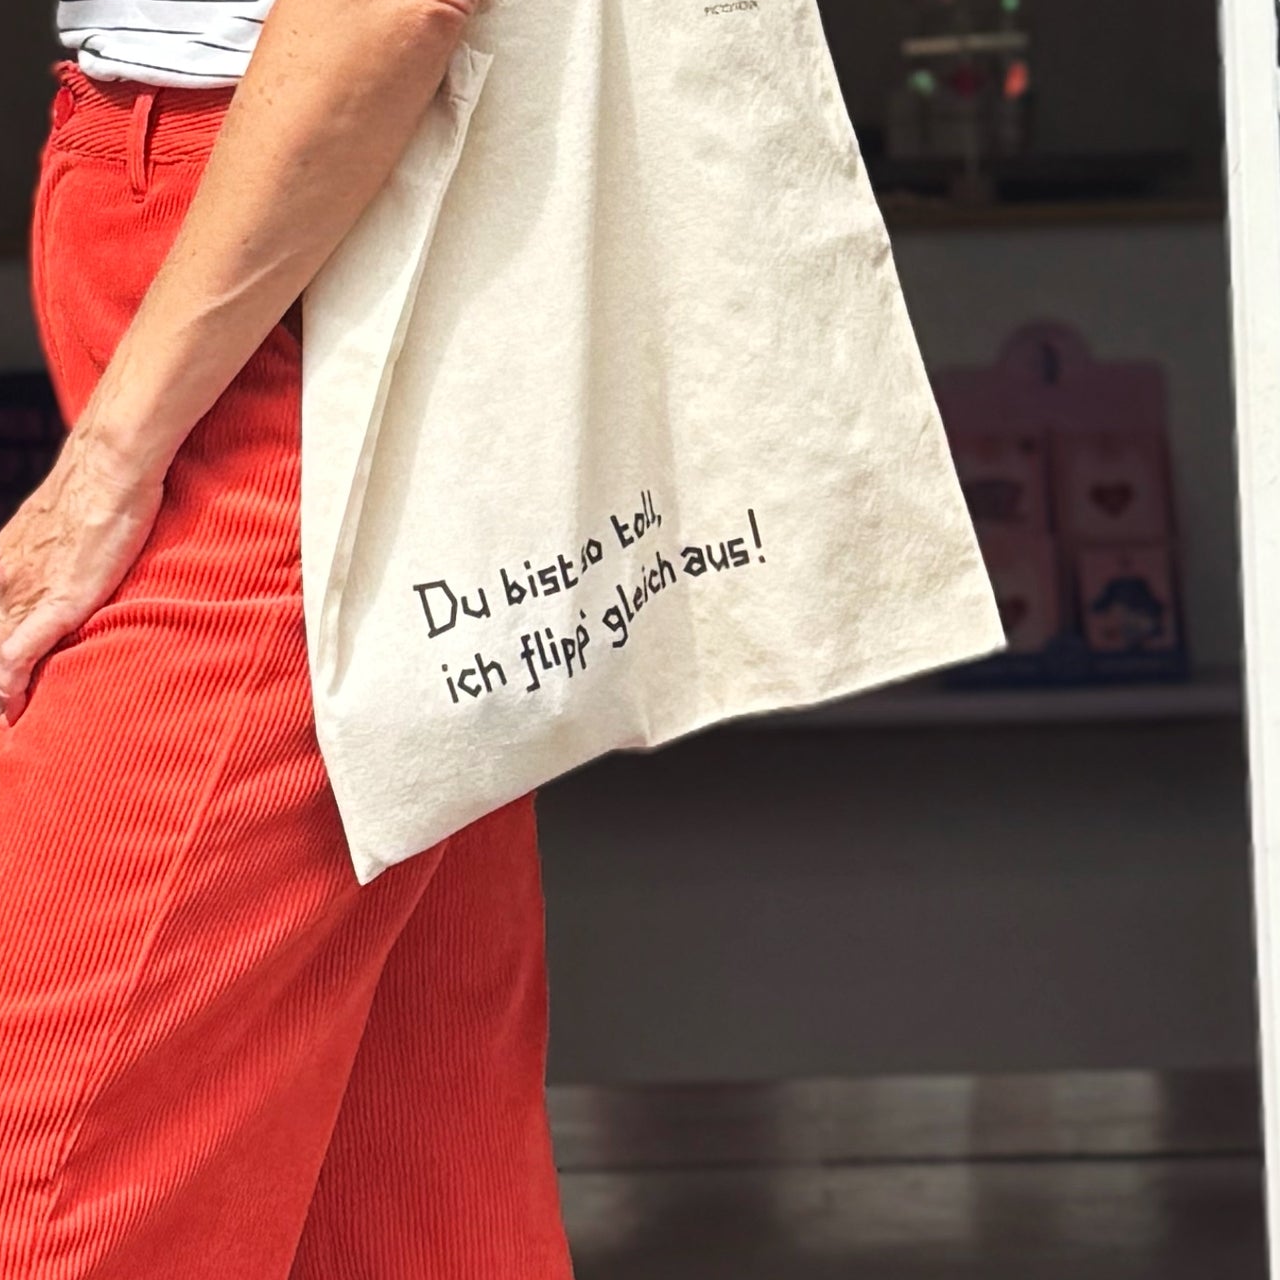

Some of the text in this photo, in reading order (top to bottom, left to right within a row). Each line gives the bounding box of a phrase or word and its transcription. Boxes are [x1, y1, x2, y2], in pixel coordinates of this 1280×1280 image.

[413, 579, 490, 638] Du
[501, 555, 579, 607] bist
[610, 490, 662, 549] toll,
[442, 653, 507, 704] ich
[603, 551, 677, 648] gleich
[681, 508, 766, 578] aus!
